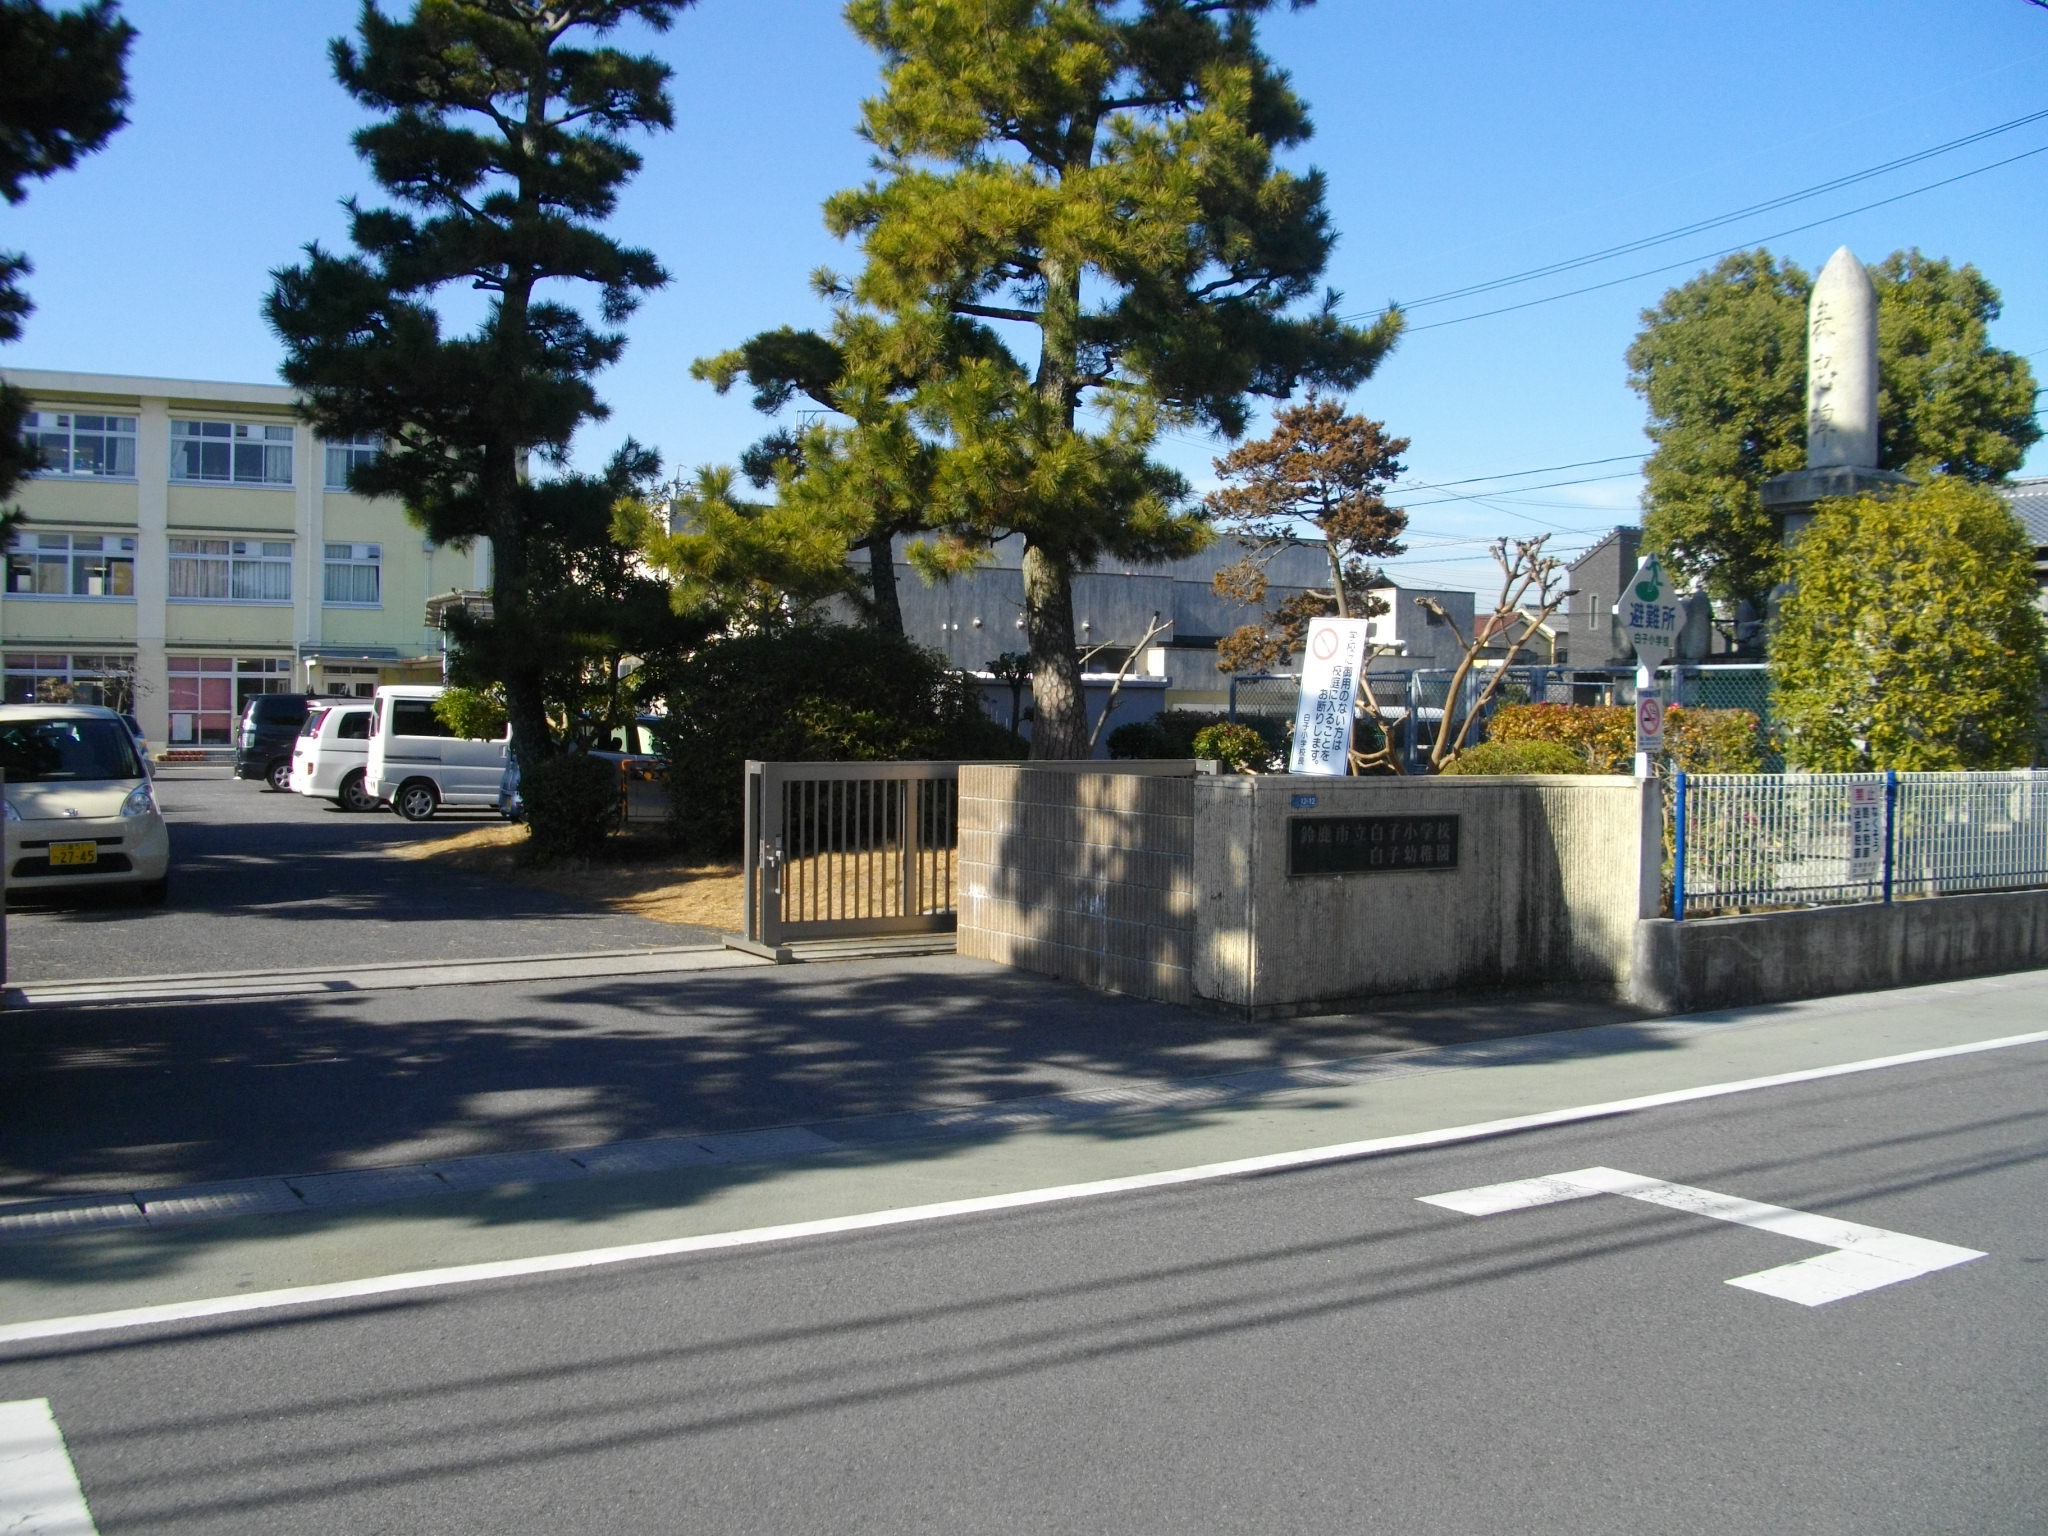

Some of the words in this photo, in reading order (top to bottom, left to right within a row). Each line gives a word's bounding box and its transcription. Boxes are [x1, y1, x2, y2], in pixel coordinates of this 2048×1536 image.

[1629, 602, 1676, 631] 避難所
[1634, 632, 1670, 647] 白子小学校
[1320, 665, 1342, 762] 校庭に入ることを
[1311, 688, 1328, 765] お断りします。
[1300, 821, 1451, 844] 鈴鹿市立白子小学校
[60, 850, 95, 863] 27-45
[1370, 844, 1451, 865] 白子幼稚園
